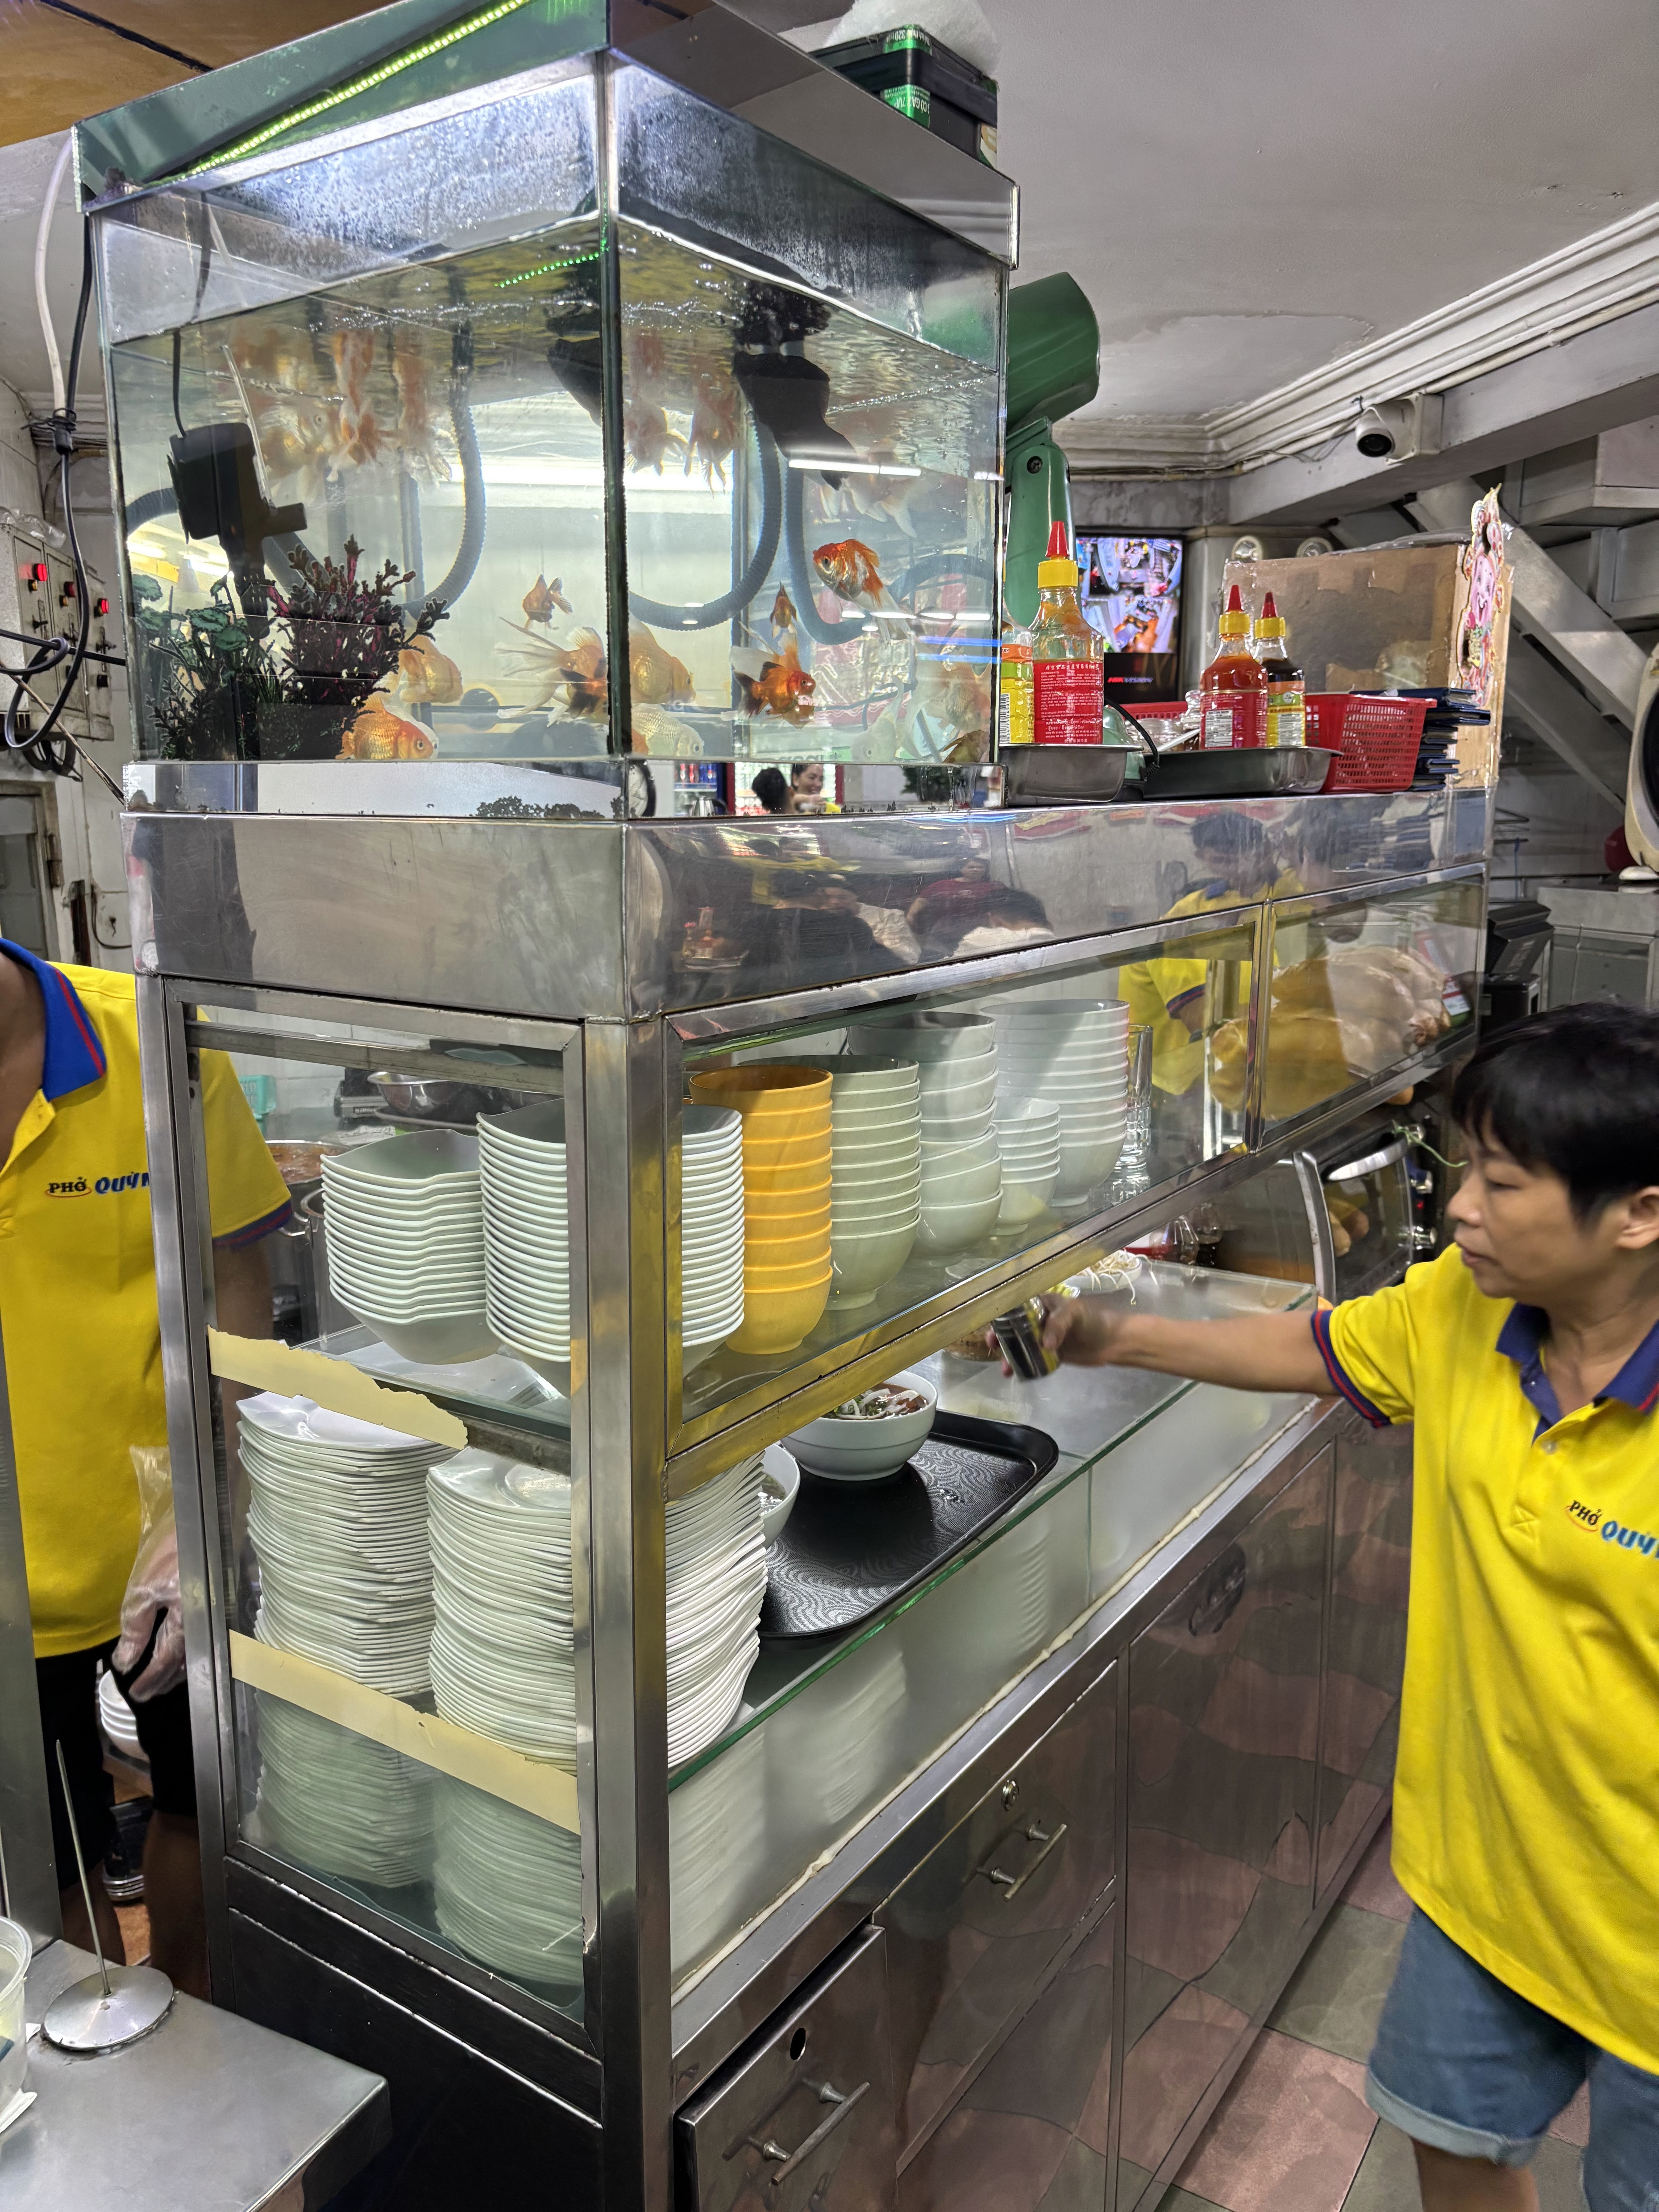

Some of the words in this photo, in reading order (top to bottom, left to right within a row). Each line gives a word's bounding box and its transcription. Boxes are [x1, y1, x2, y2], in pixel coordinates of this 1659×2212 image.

[895, 30, 906, 41] 320
[894, 96, 906, 109] 7UP
[921, 99, 927, 113] CÓ
[49, 1176, 87, 1194] PHỞ
[1569, 1500, 1602, 1526] PHỞ
[1602, 1520, 1659, 1559] QUỲ
